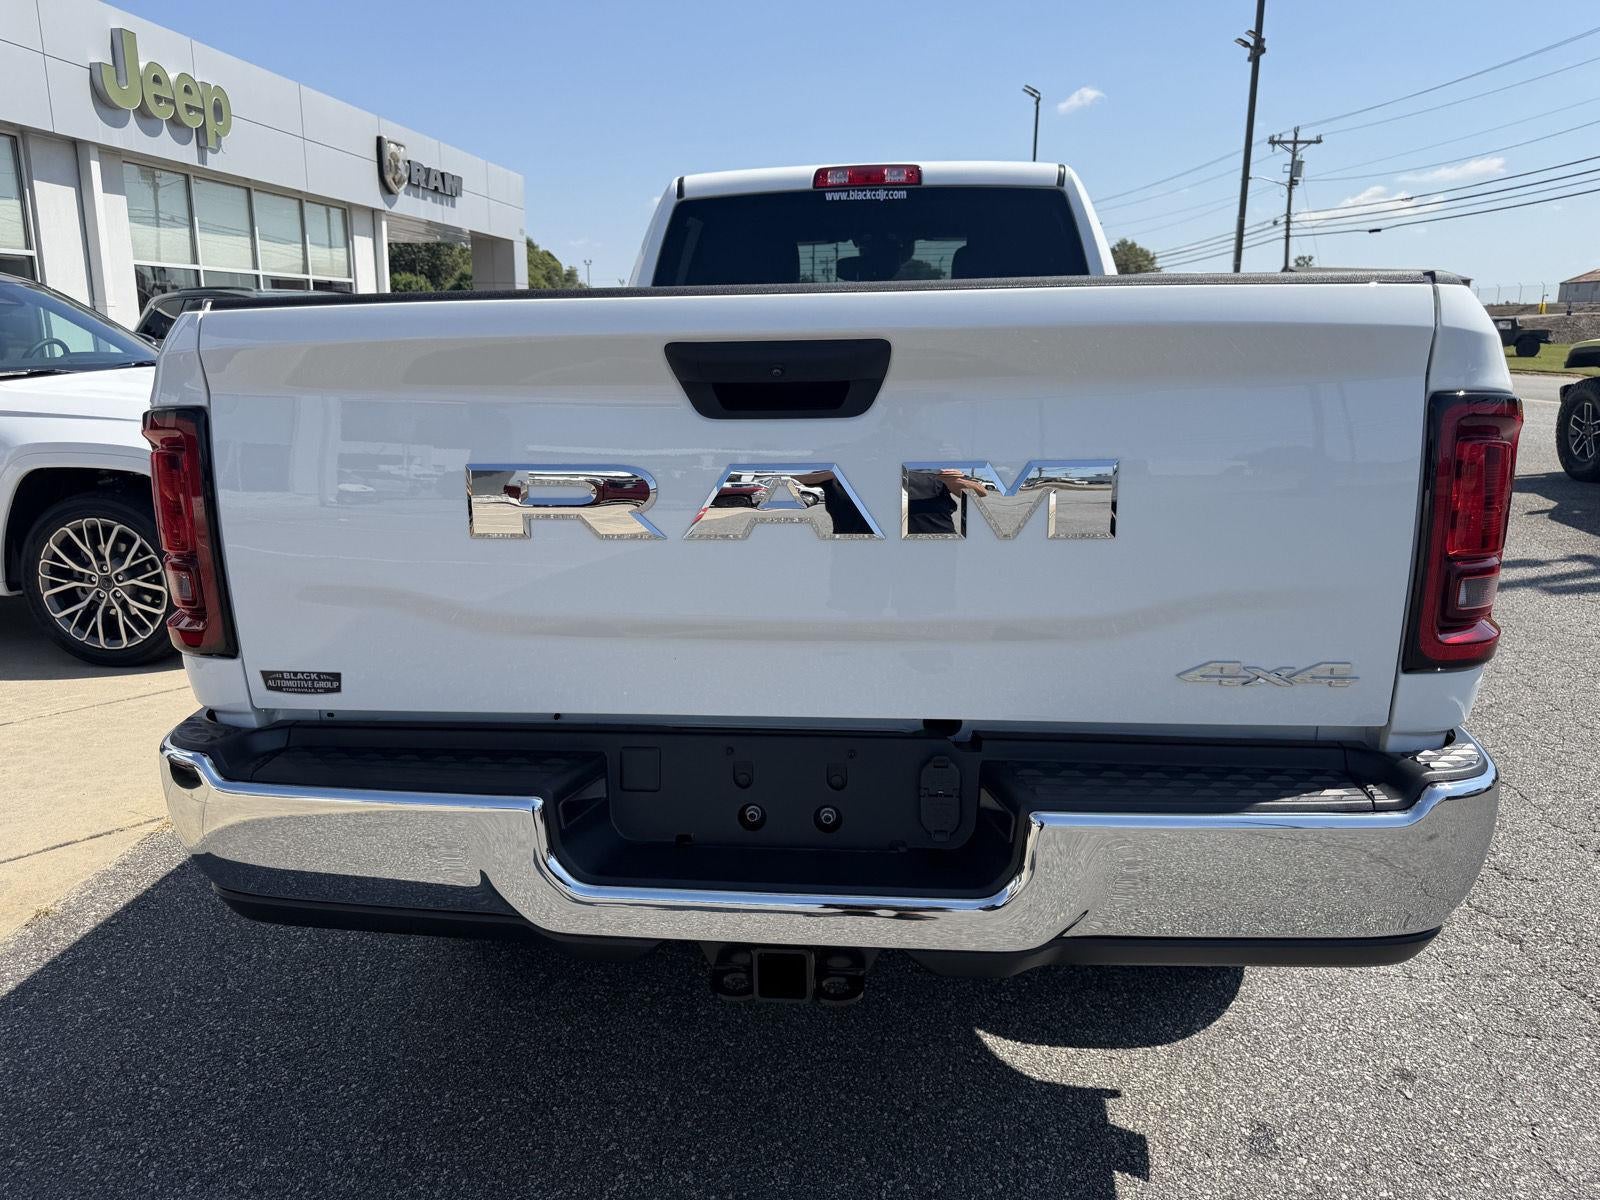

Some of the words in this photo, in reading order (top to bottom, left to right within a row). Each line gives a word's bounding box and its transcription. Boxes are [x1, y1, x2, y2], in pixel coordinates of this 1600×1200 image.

[89, 27, 232, 150] Jeep
[408, 159, 463, 198] RAM
[825, 189, 907, 201] www.blackcdjr.com
[466, 459, 1120, 541] RAM
[267, 680, 313, 688] AUTOMOTIVE
[314, 681, 340, 689] GROUP
[283, 672, 319, 680] BLACK
